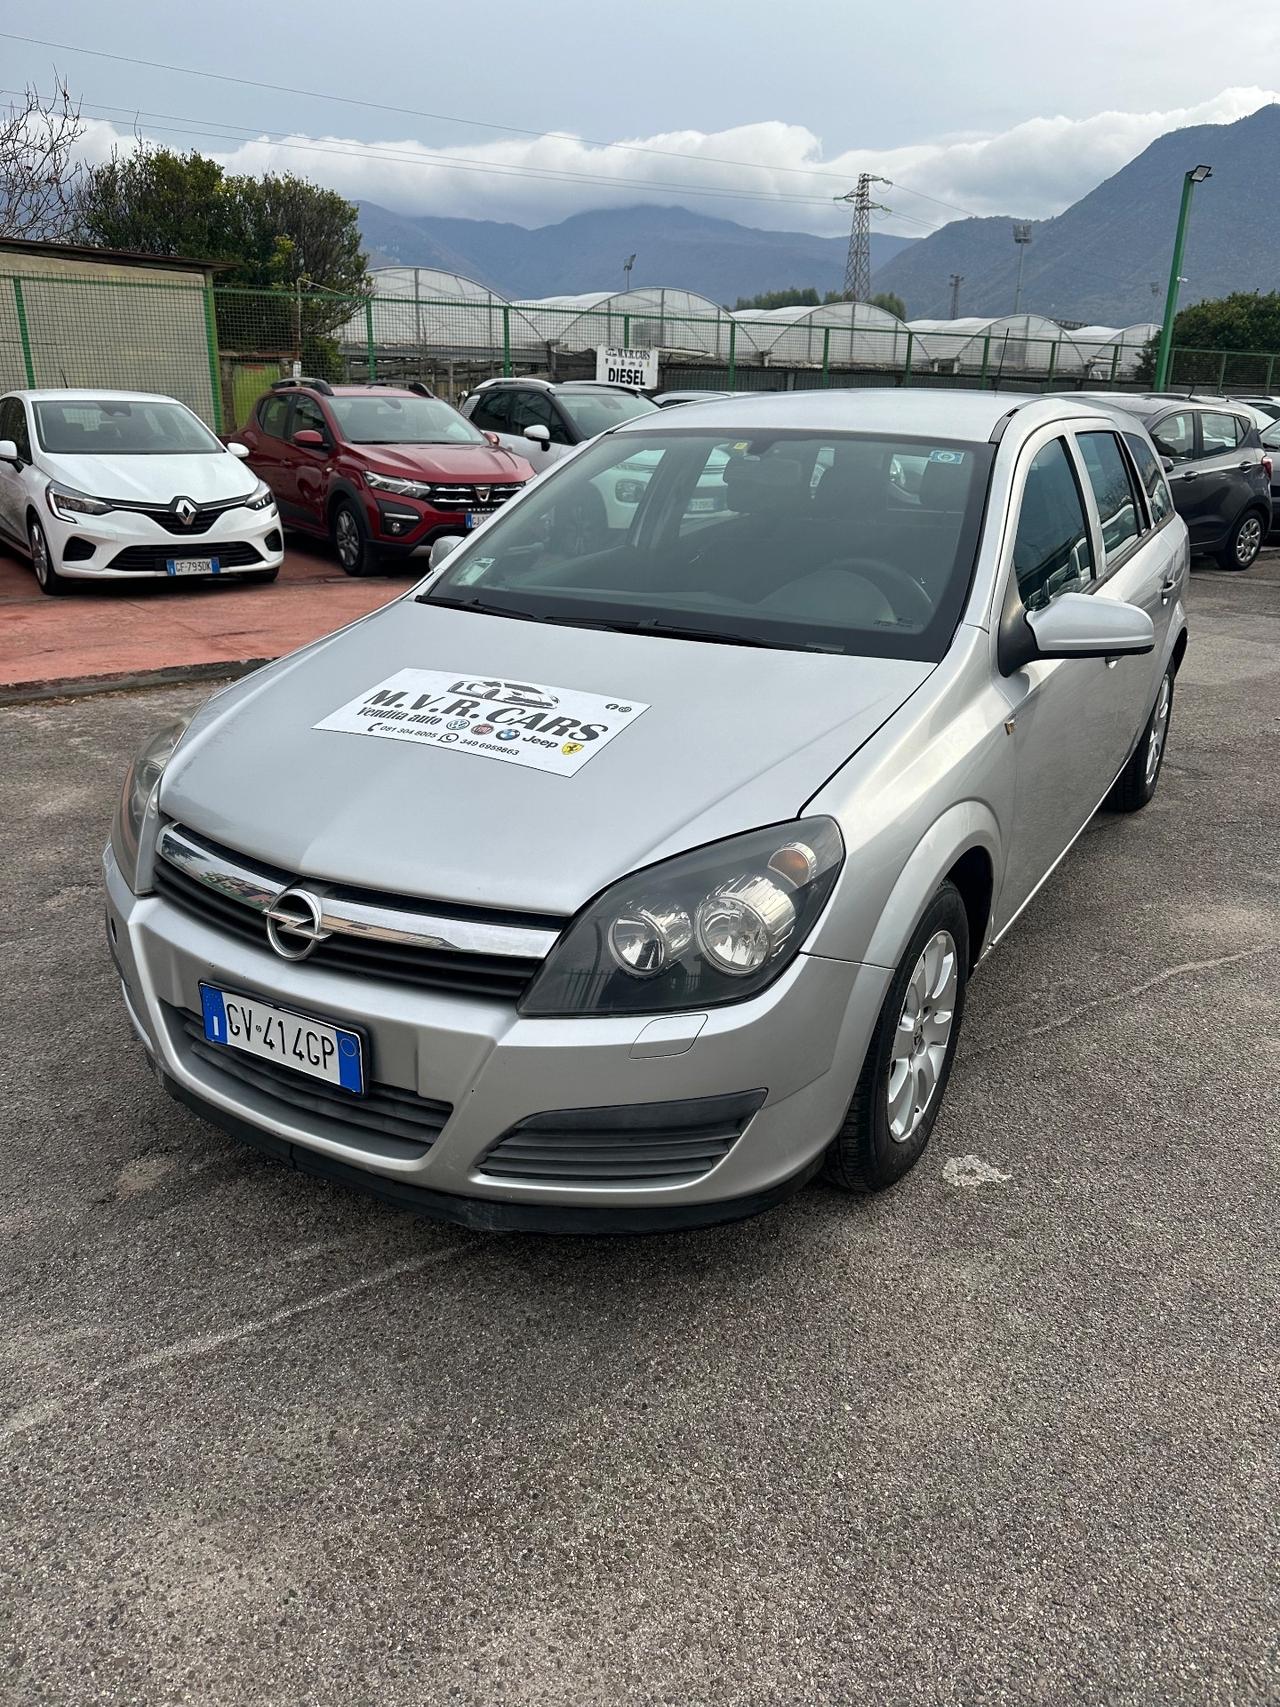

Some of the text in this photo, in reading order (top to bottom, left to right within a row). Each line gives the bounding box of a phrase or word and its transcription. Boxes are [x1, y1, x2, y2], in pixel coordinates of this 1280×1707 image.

[608, 367, 646, 386] DIESEL
[356, 707, 409, 721] Vendita
[407, 714, 443, 726] auto
[363, 689, 609, 742] M.V.R. CARS
[459, 739, 479, 747] 349
[521, 735, 559, 749] Jeep
